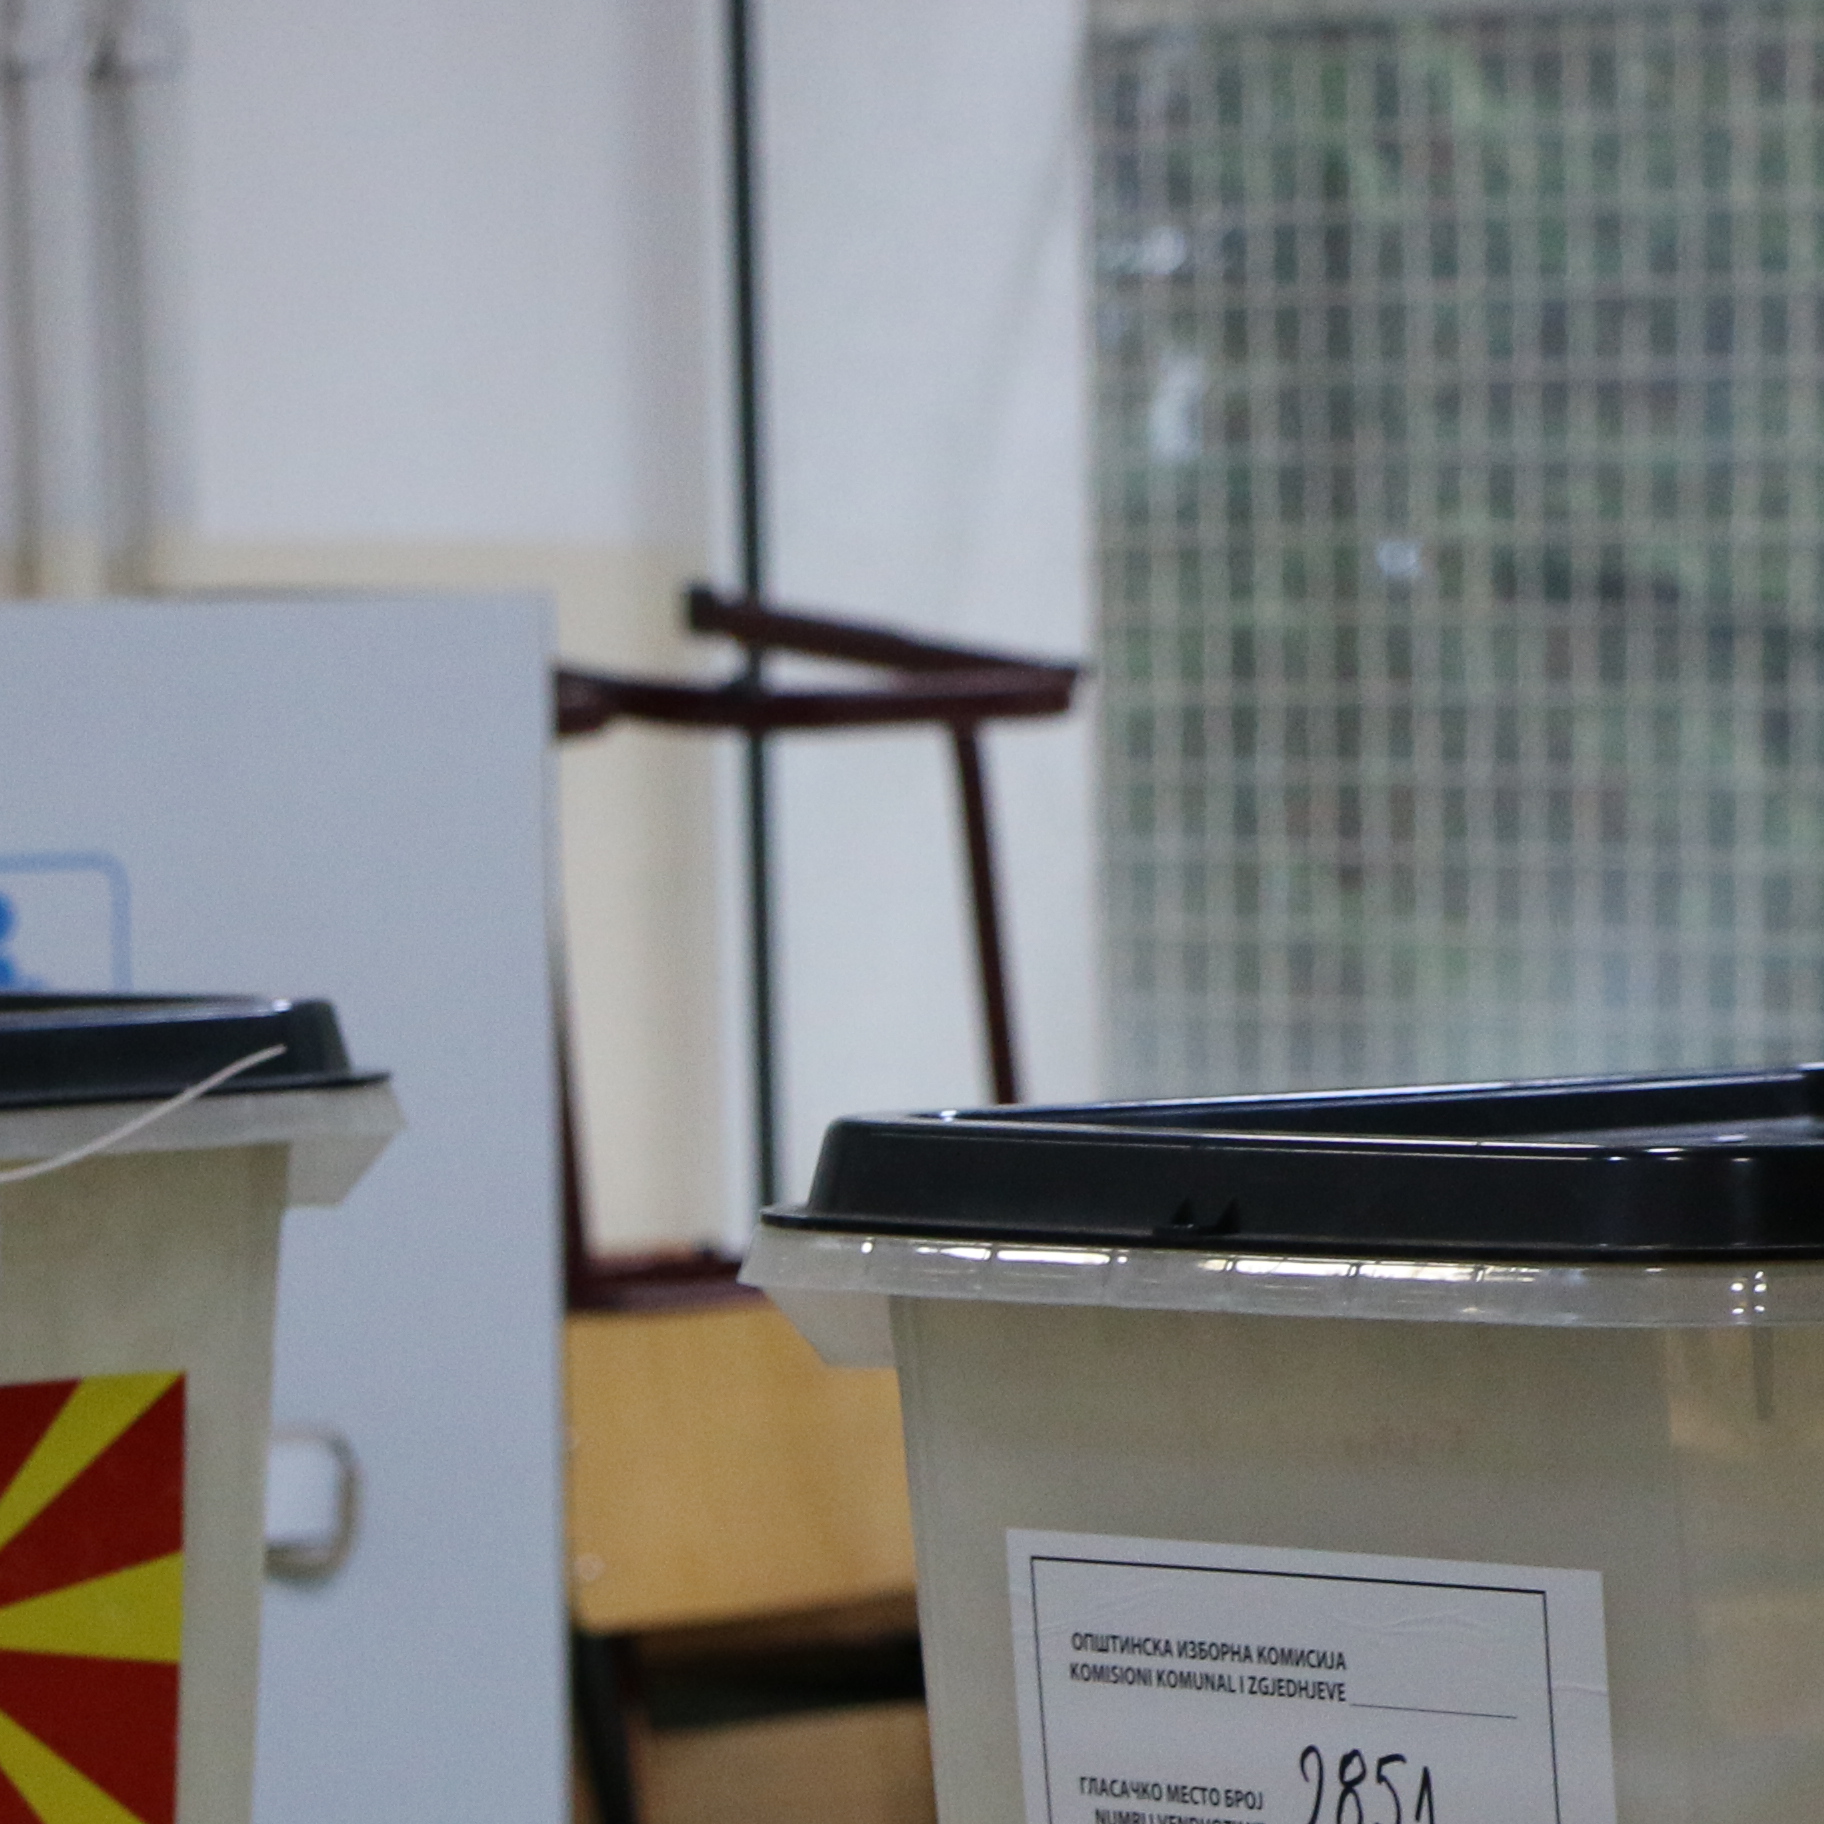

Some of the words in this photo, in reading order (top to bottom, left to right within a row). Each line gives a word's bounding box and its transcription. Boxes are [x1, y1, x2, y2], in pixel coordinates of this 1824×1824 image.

[1071, 1632, 1173, 1658] ОПШТИНСКА
[1177, 1640, 1254, 1664] ИЗБОРНА
[1257, 1646, 1347, 1671] КОМИСИЈА
[1069, 1662, 1153, 1687] KOMISIONI
[1156, 1671, 1235, 1694] KOMUNAL
[1248, 1675, 1346, 1702] ZGJEDHJEVE
[1079, 1776, 1163, 1802] ГЛАСАЧКО
[1166, 1784, 1221, 1806] МЕСТО
[1224, 1789, 1264, 1811] БРОЈ
